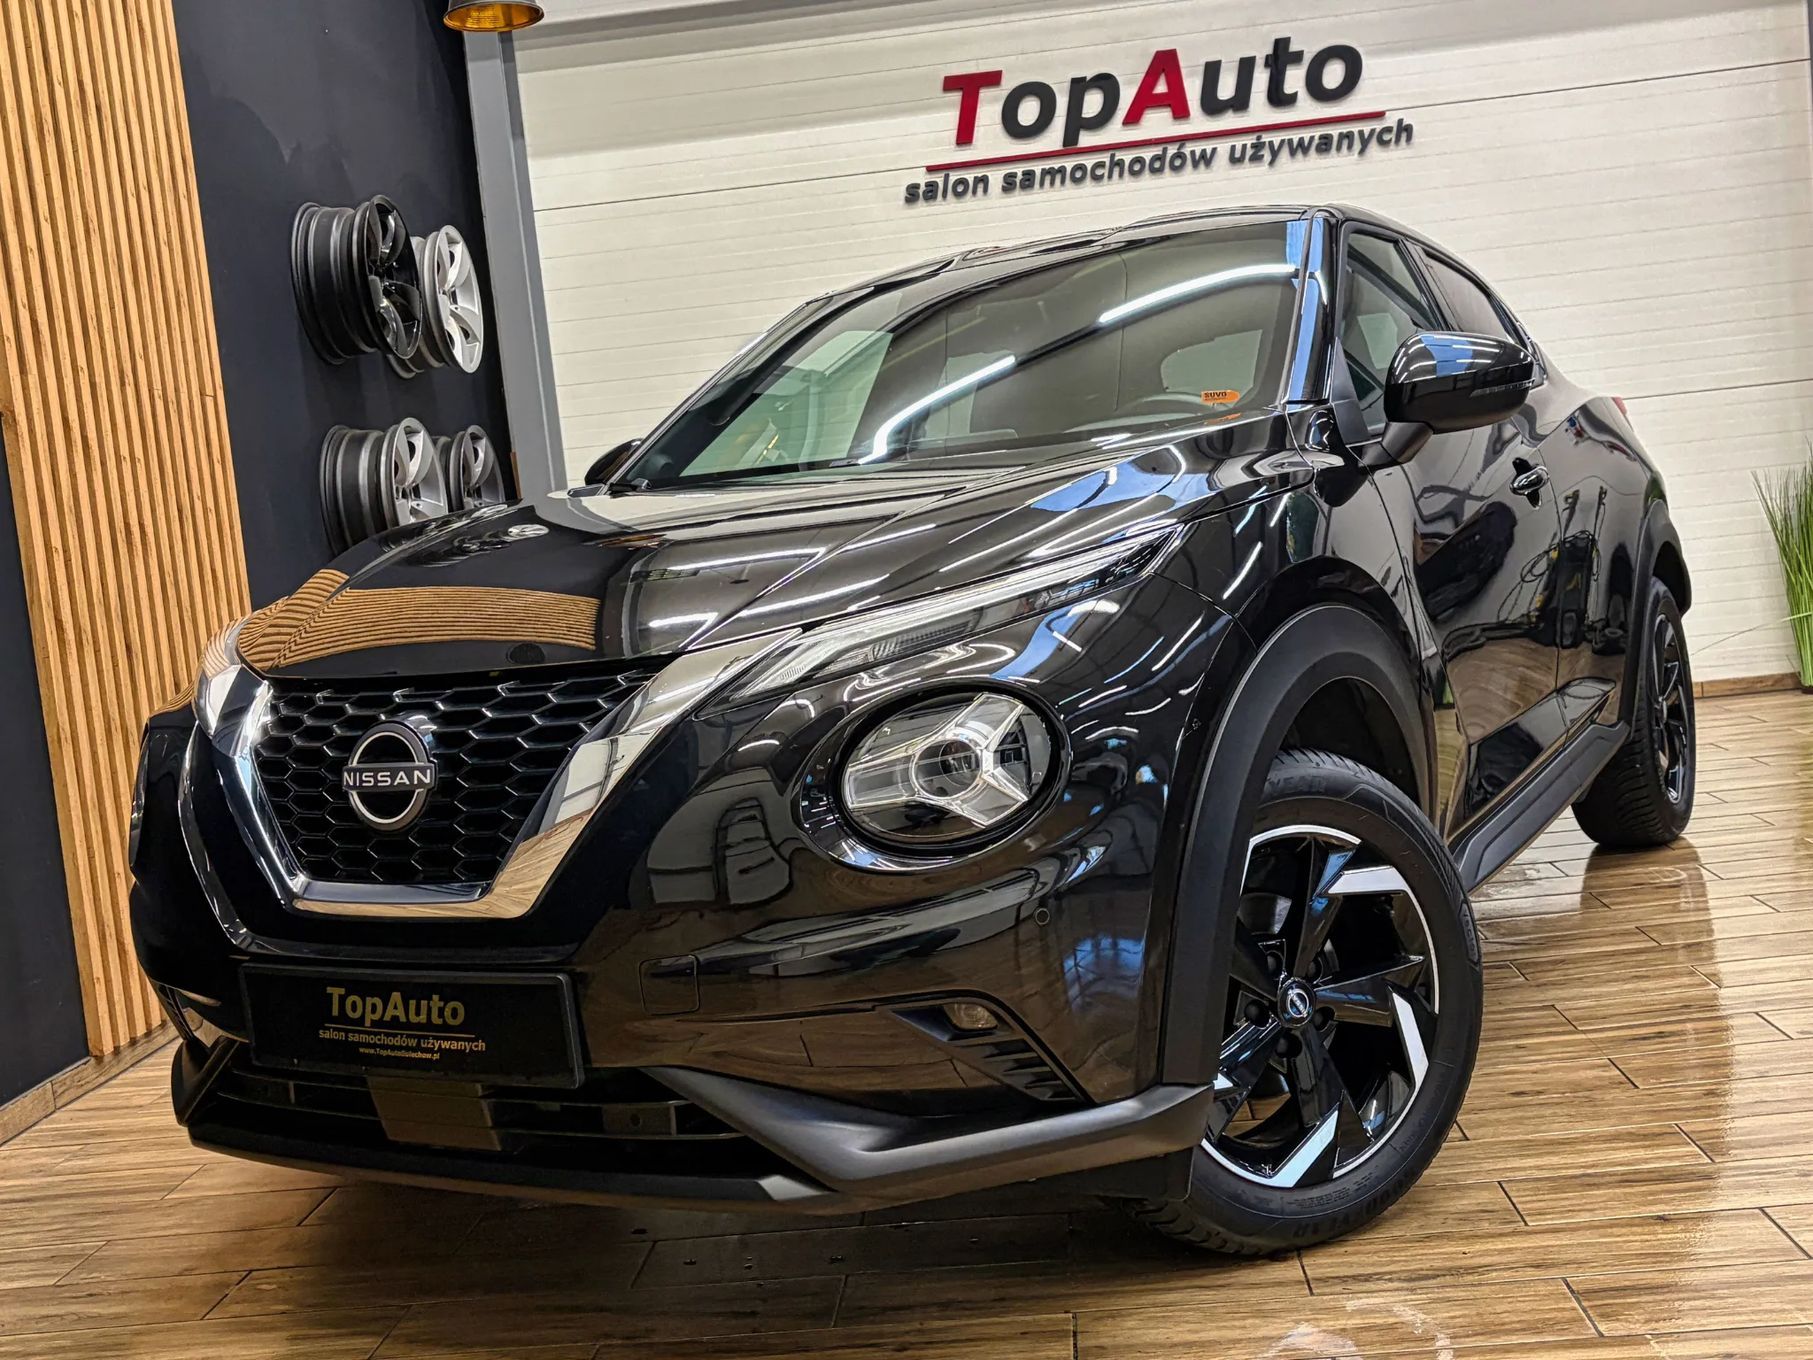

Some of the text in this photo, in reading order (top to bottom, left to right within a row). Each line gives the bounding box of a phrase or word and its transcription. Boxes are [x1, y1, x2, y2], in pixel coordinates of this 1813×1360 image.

[942, 36, 1363, 147] TopAuto
[904, 118, 1414, 204] salon samochodów używanych
[343, 769, 431, 787] NISSAN
[326, 986, 465, 1027] TopAuto
[318, 1028, 486, 1052] salon samochodów używanych
